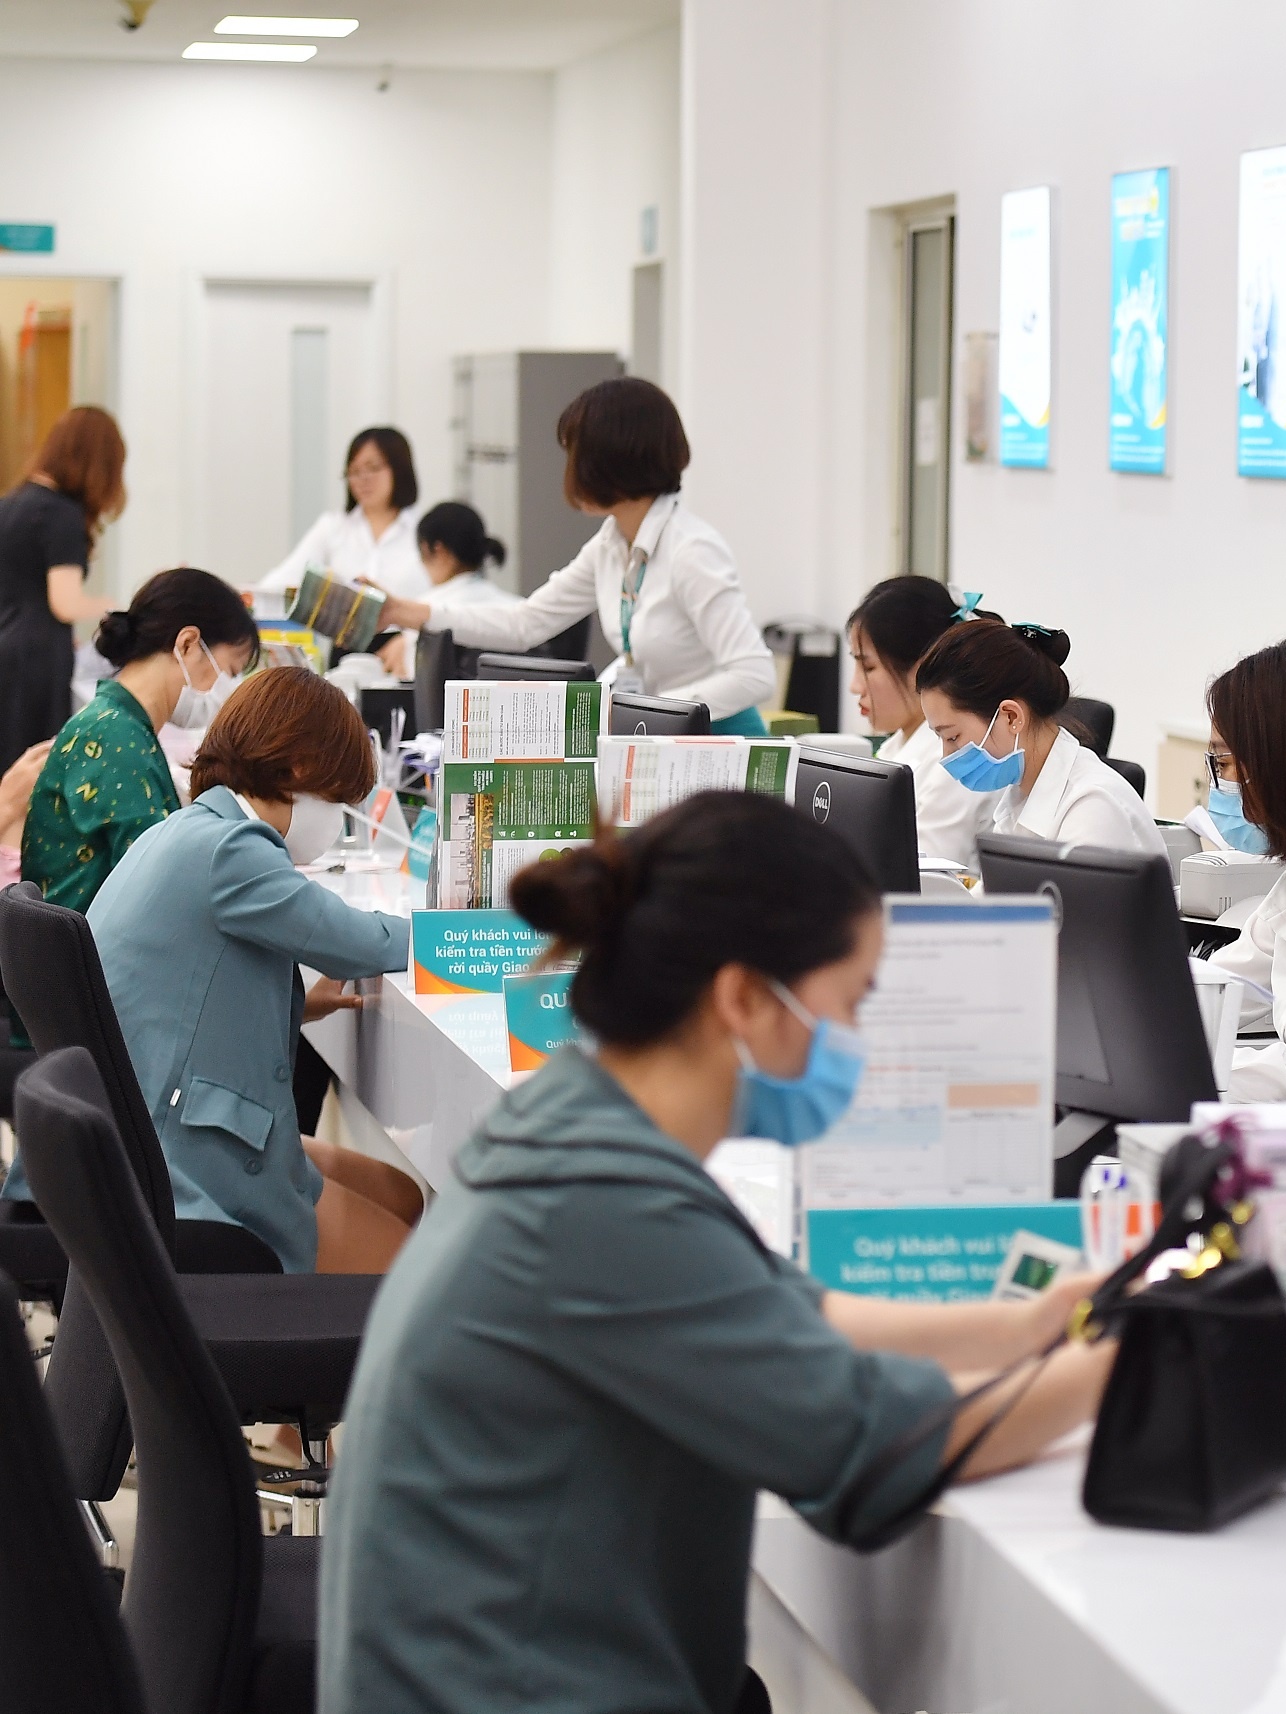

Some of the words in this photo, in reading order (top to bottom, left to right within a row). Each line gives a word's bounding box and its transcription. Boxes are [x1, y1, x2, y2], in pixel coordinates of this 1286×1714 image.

[444, 929, 469, 943] Quý
[472, 929, 510, 941] khách
[512, 930, 531, 941] vui
[435, 943, 466, 958] kiểm
[469, 946, 487, 958] tra
[489, 943, 514, 957] tiền
[448, 961, 466, 974] rời
[468, 961, 499, 977] quầy
[502, 961, 530, 974] Giao
